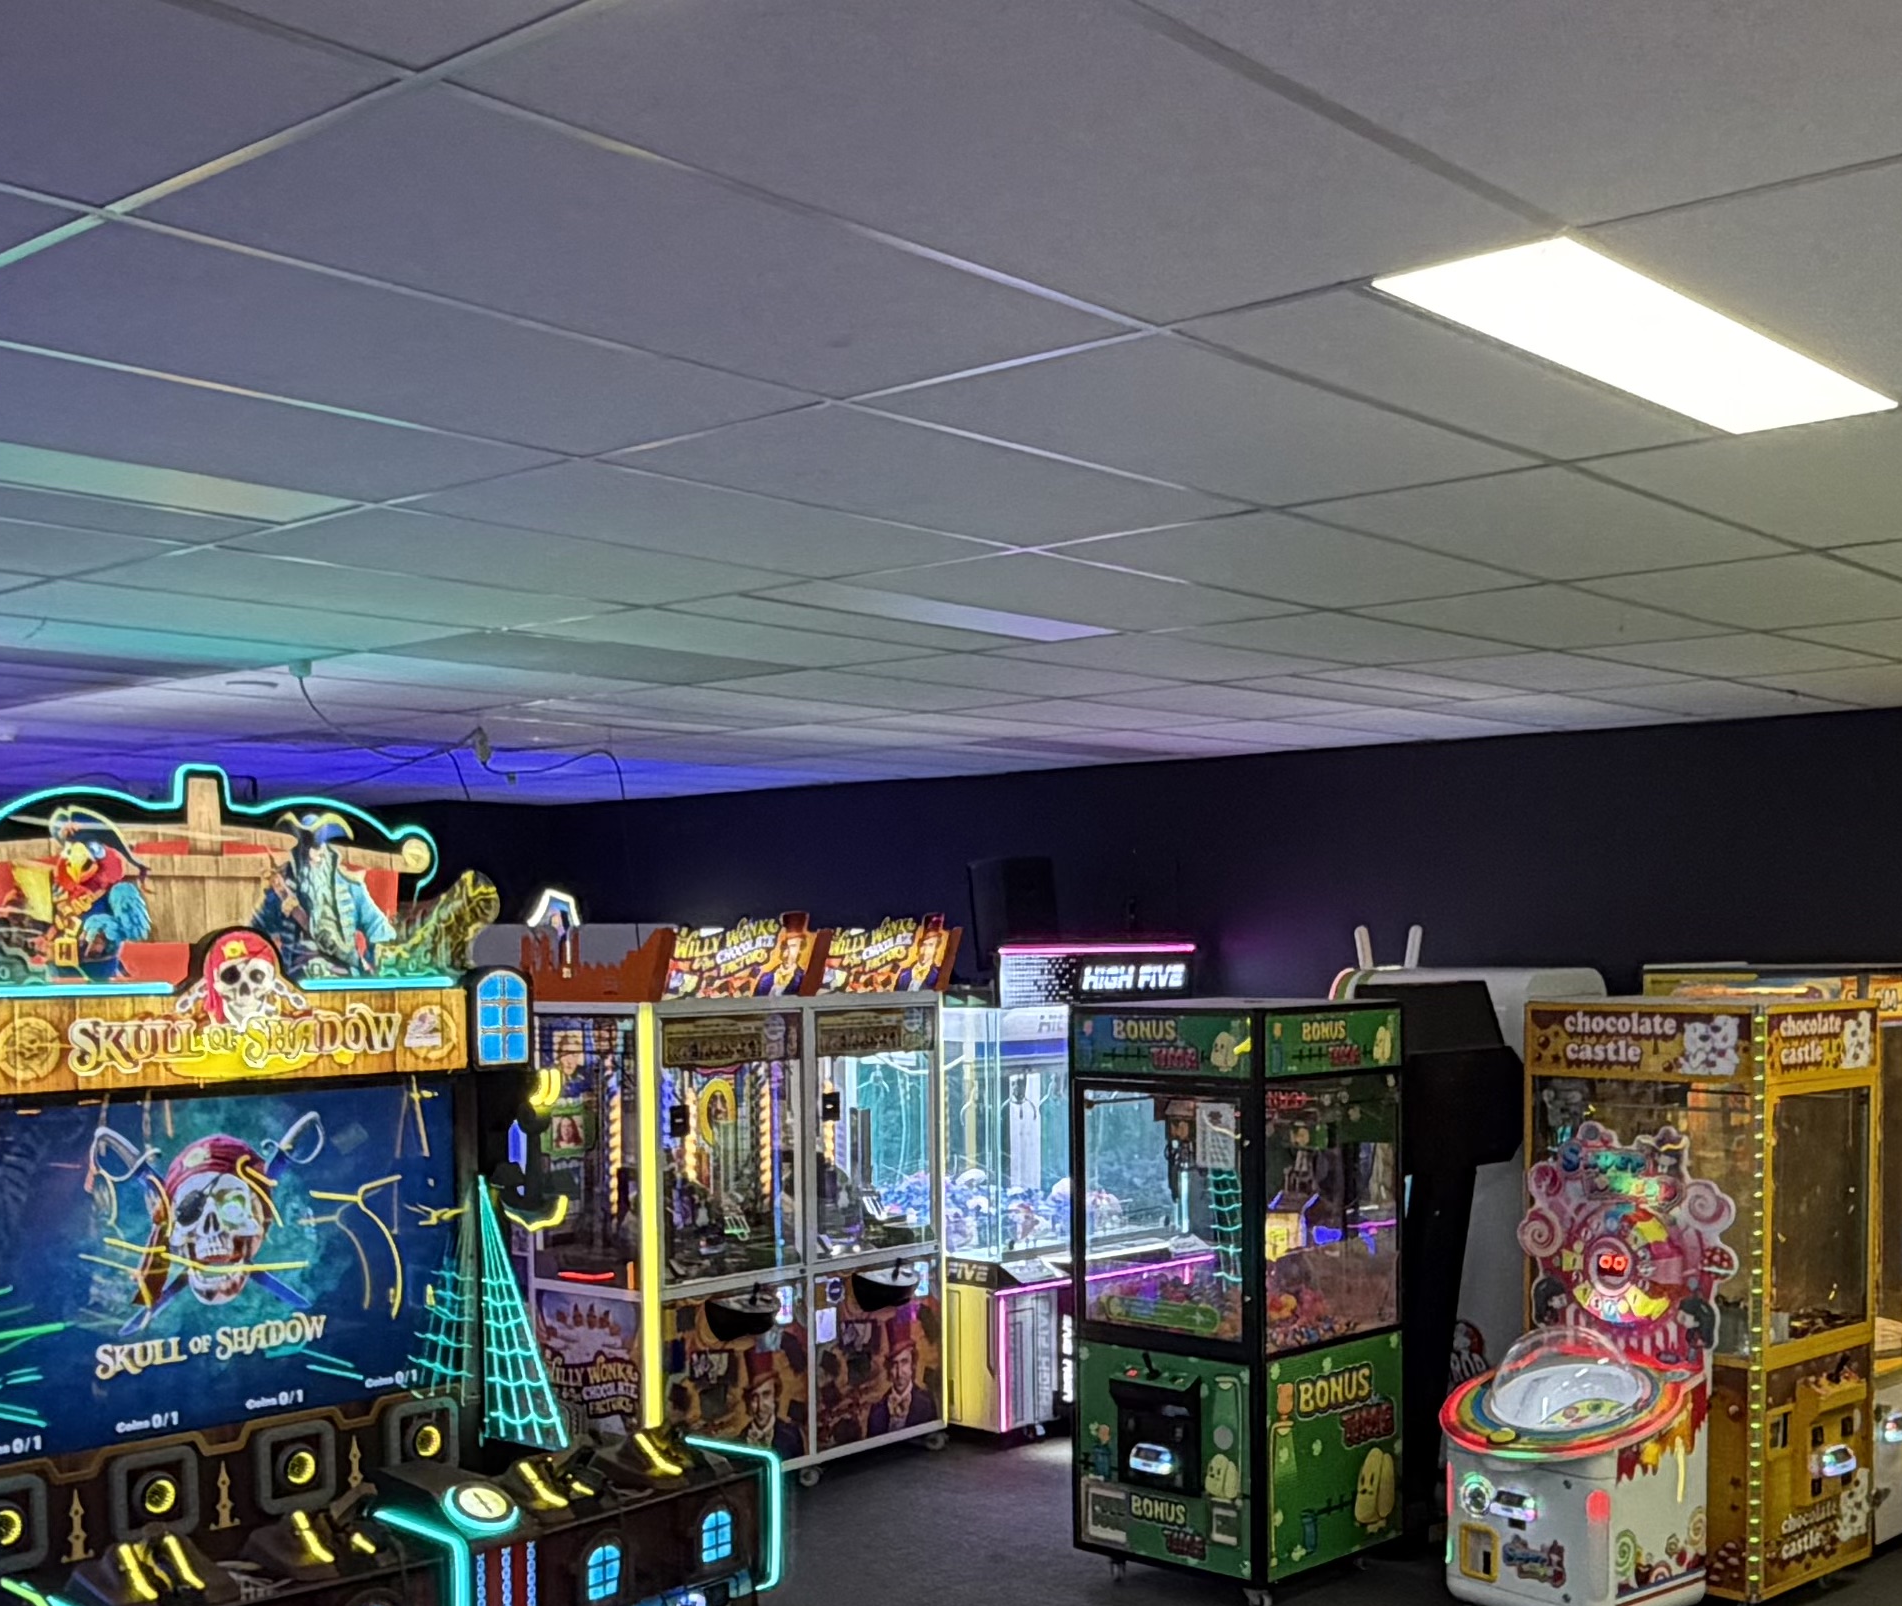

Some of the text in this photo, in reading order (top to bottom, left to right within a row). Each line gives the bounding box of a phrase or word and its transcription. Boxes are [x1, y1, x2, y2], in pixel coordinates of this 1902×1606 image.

[1082, 963, 1186, 990] HIGH FIVE
[1113, 1018, 1177, 1041] BONUS
[1302, 1020, 1346, 1042] BONUS
[1564, 1011, 1677, 1036] chocolate
[1780, 1013, 1842, 1038] chocolate
[68, 1018, 205, 1076] SKULL
[241, 1004, 400, 1068] SHADOW
[1566, 1041, 1642, 1063] castle
[1781, 1044, 1825, 1066] castle
[948, 1261, 989, 1283] FIVE
[95, 1337, 187, 1380] SKULL
[216, 1312, 327, 1360] SHADOW
[1299, 1367, 1370, 1412] BONUS
[1130, 1494, 1186, 1525] BONUS
[1782, 1529, 1824, 1560] castle
